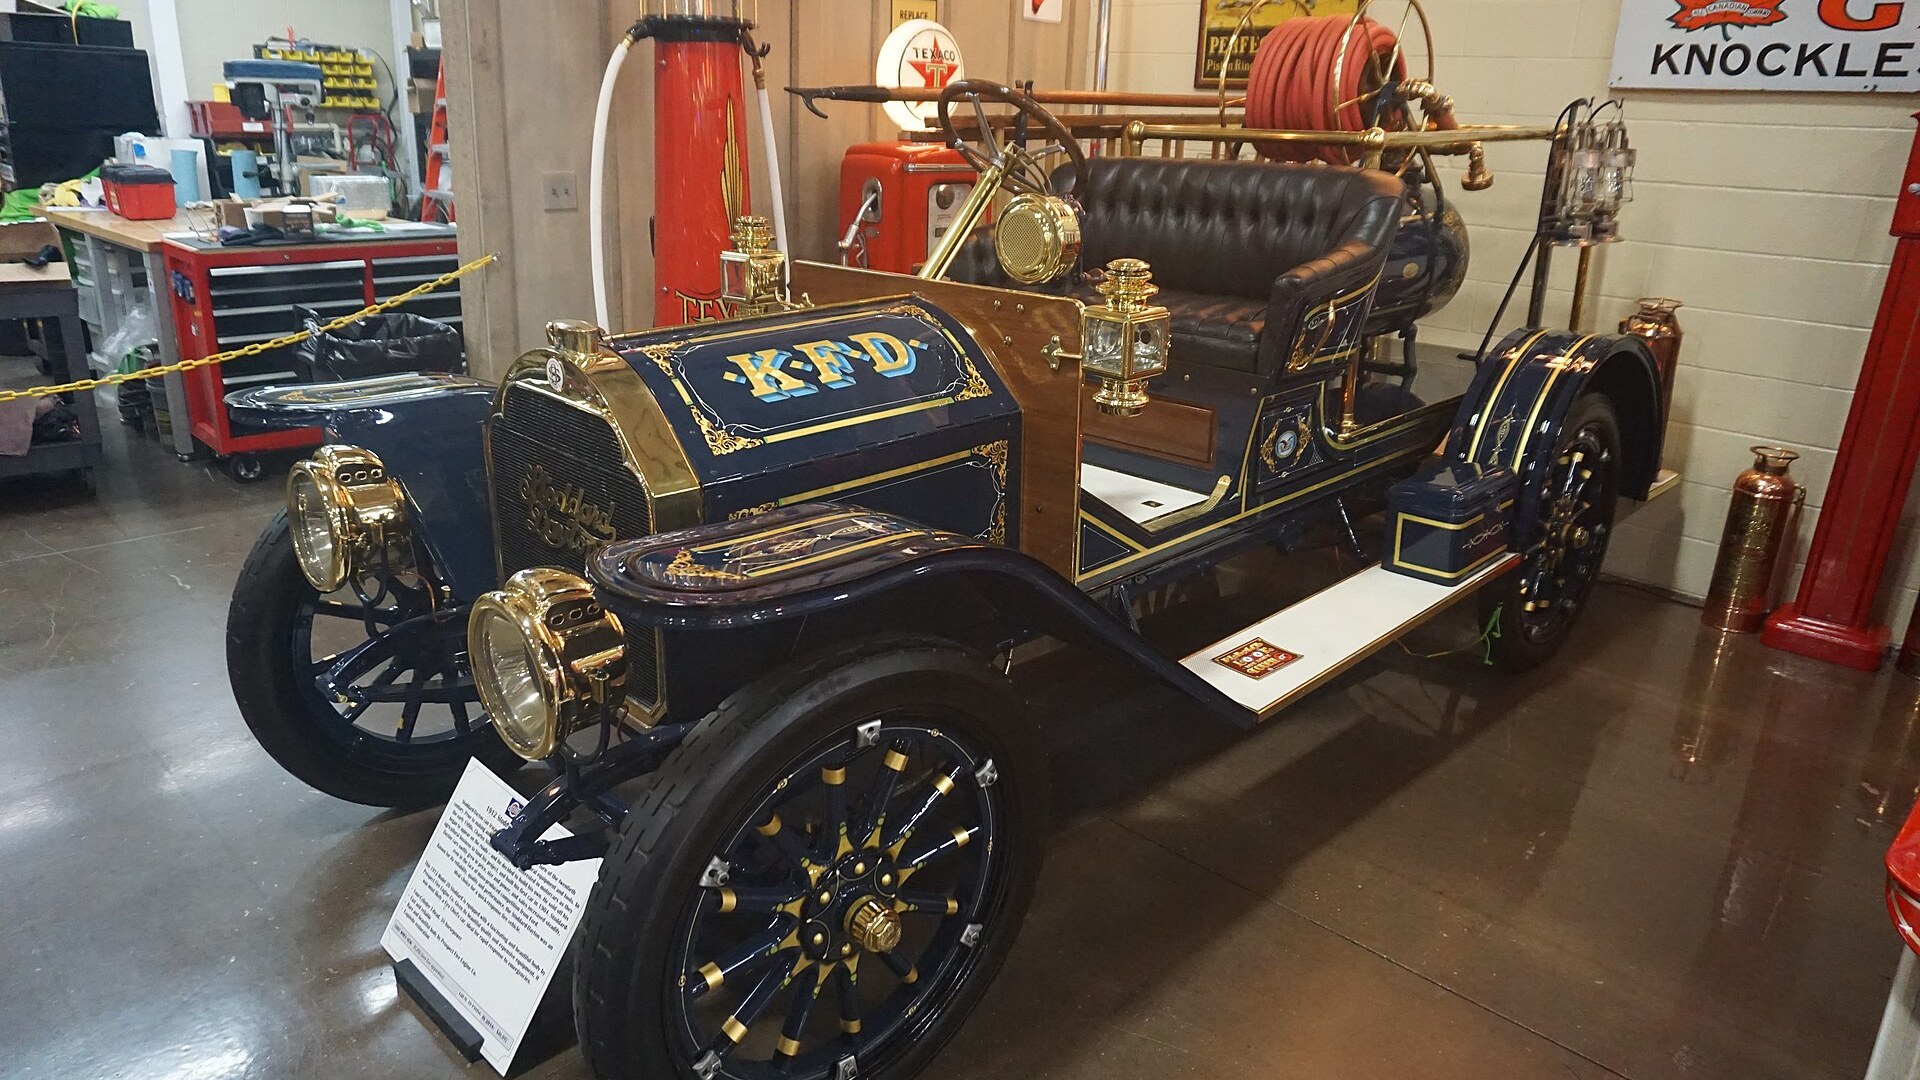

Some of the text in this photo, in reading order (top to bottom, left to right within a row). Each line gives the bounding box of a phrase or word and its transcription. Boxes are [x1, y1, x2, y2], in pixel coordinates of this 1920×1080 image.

[899, 10, 928, 20] REPLACE
[1708, 3, 1747, 11] CANADIAN
[1209, 36, 1261, 54] PERFE
[913, 47, 955, 62] TEXACO
[1650, 42, 1920, 77] KNOCKLE
[1207, 59, 1253, 71] Pistn Rin
[675, 289, 733, 324] TEX
[502, 863, 515, 876] decided
[537, 873, 556, 890] equipment
[558, 879, 576, 895] twentieth
[540, 885, 559, 902] motorcars
[500, 893, 520, 911] competition
[528, 905, 546, 922] increased
[466, 902, 480, 917] equipped
[490, 924, 508, 943] fascinating
[515, 946, 532, 963] beautiful
[488, 944, 503, 959] response
[499, 943, 515, 959] expensive
